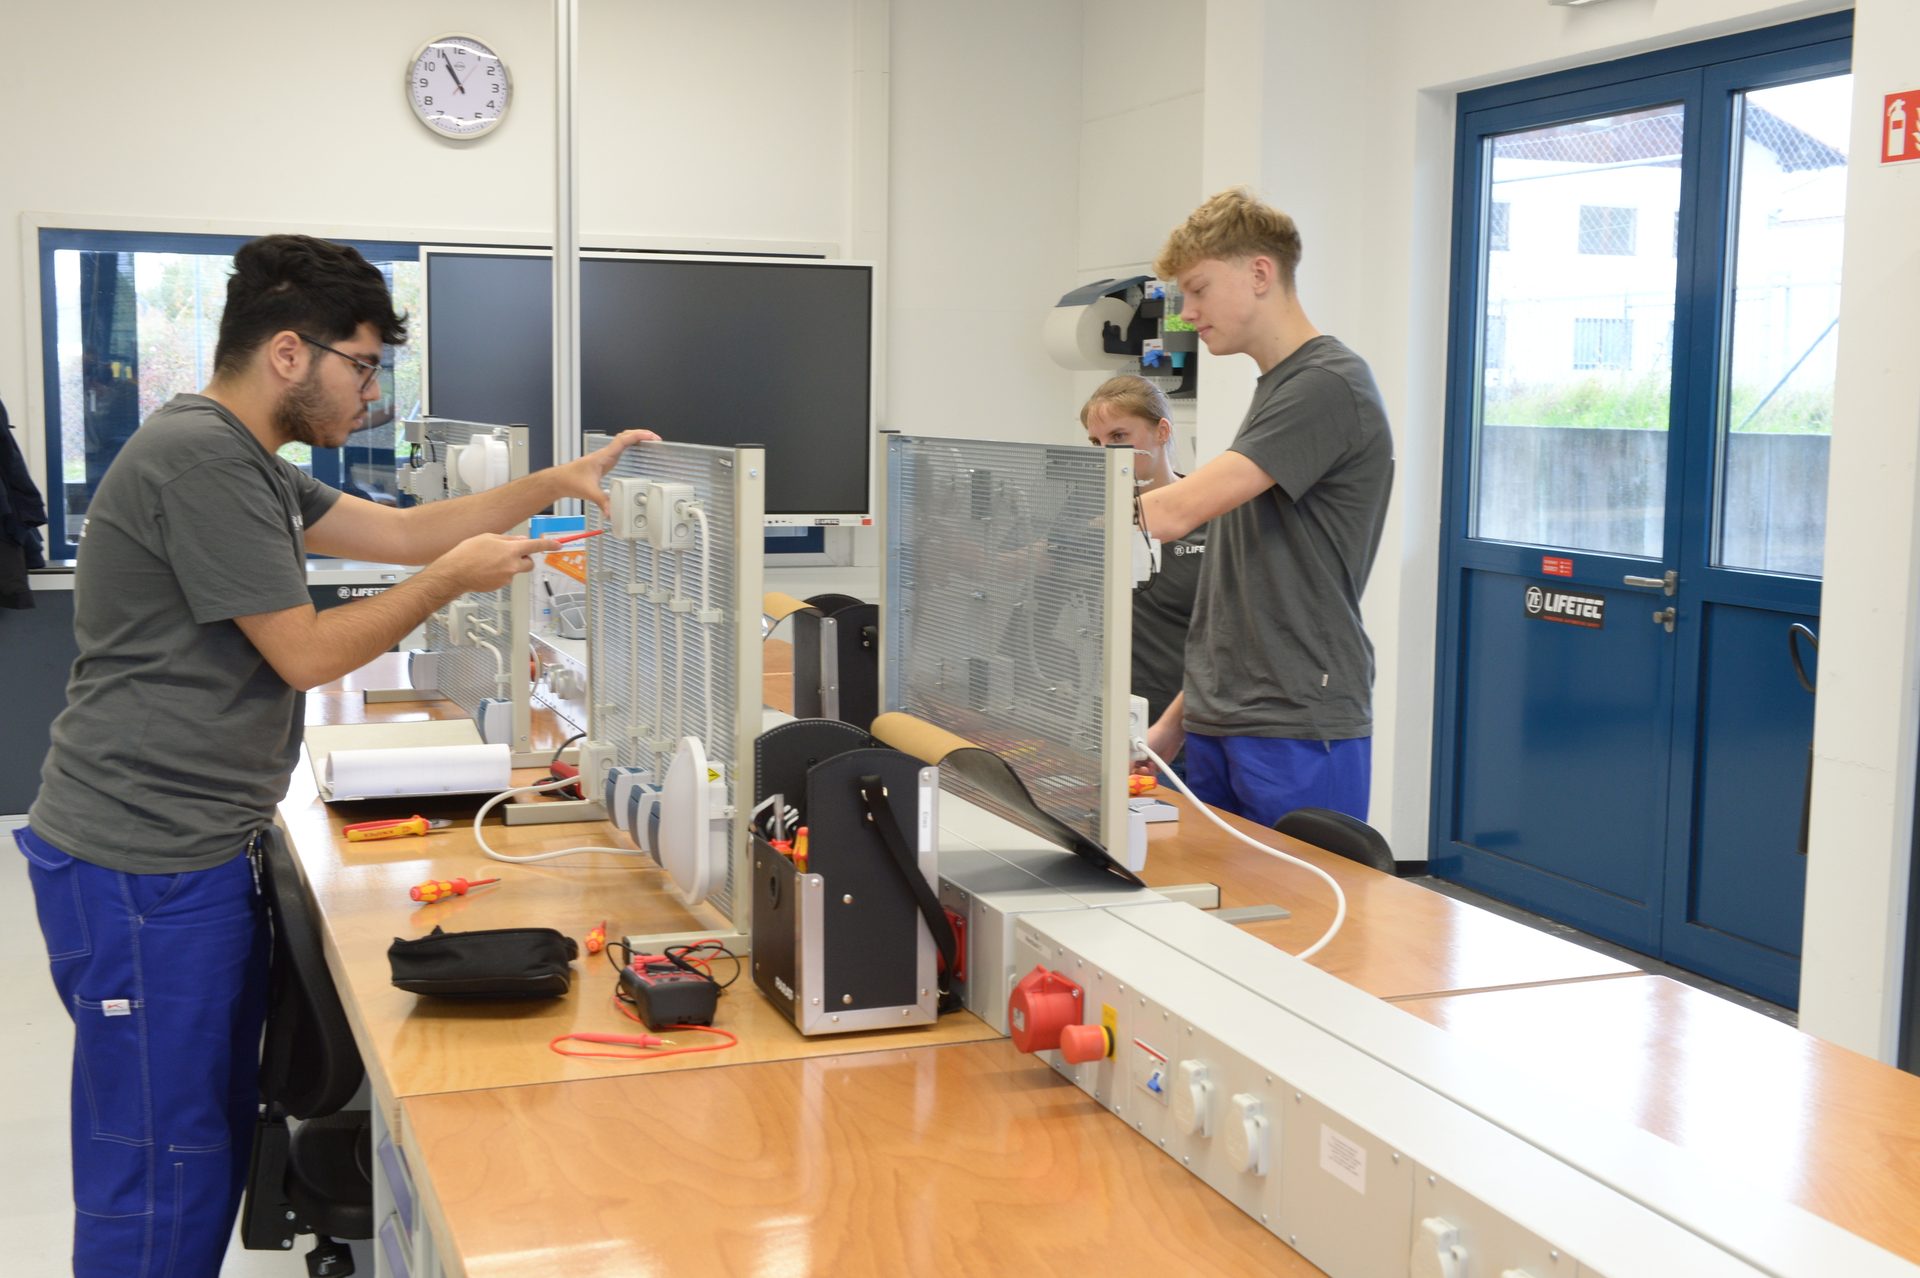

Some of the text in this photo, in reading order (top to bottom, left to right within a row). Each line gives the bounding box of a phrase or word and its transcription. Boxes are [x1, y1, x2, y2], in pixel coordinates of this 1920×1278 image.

[424, 61, 436, 72] 10
[487, 65, 496, 76] 2
[419, 78, 429, 88] 9
[491, 83, 500, 93] 3
[424, 96, 433, 106] 8
[486, 99, 495, 109] 4
[1185, 545, 1206, 554] LIFE
[351, 587, 388, 597] LIFET
[1544, 592, 1604, 619] LIFETEC
